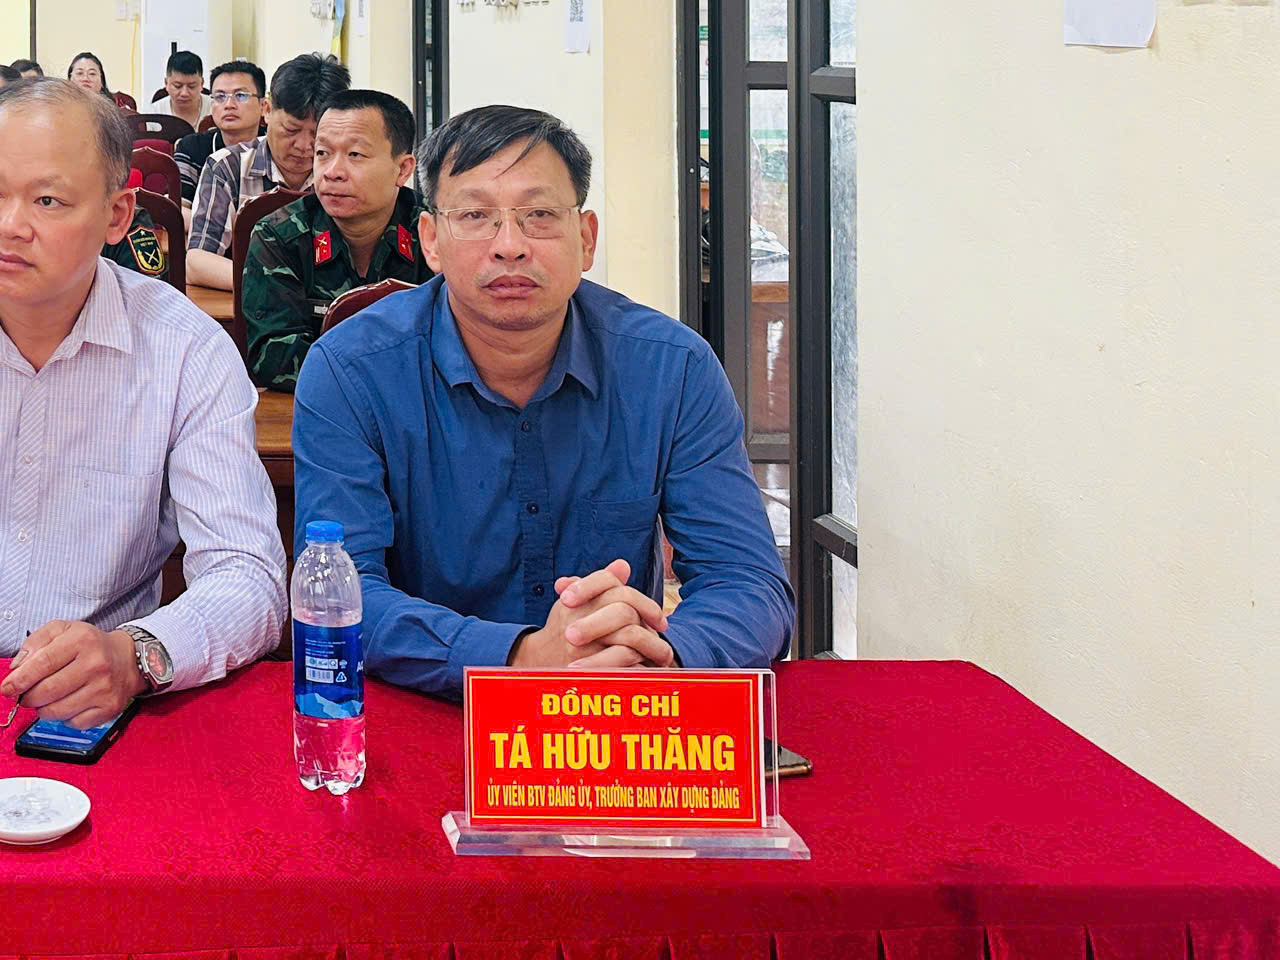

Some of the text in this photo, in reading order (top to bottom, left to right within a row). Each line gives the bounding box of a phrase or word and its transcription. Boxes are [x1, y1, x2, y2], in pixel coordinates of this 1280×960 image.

[542, 687, 680, 717] ĐỒNG CHÍ
[490, 725, 735, 771] TÁ HỮU THĂNG
[487, 777, 740, 813] ỦY VIÊN BTV ĐẢNG ỦY, TRƯỞNG BAN XÂY DỰNG ĐẢNG
